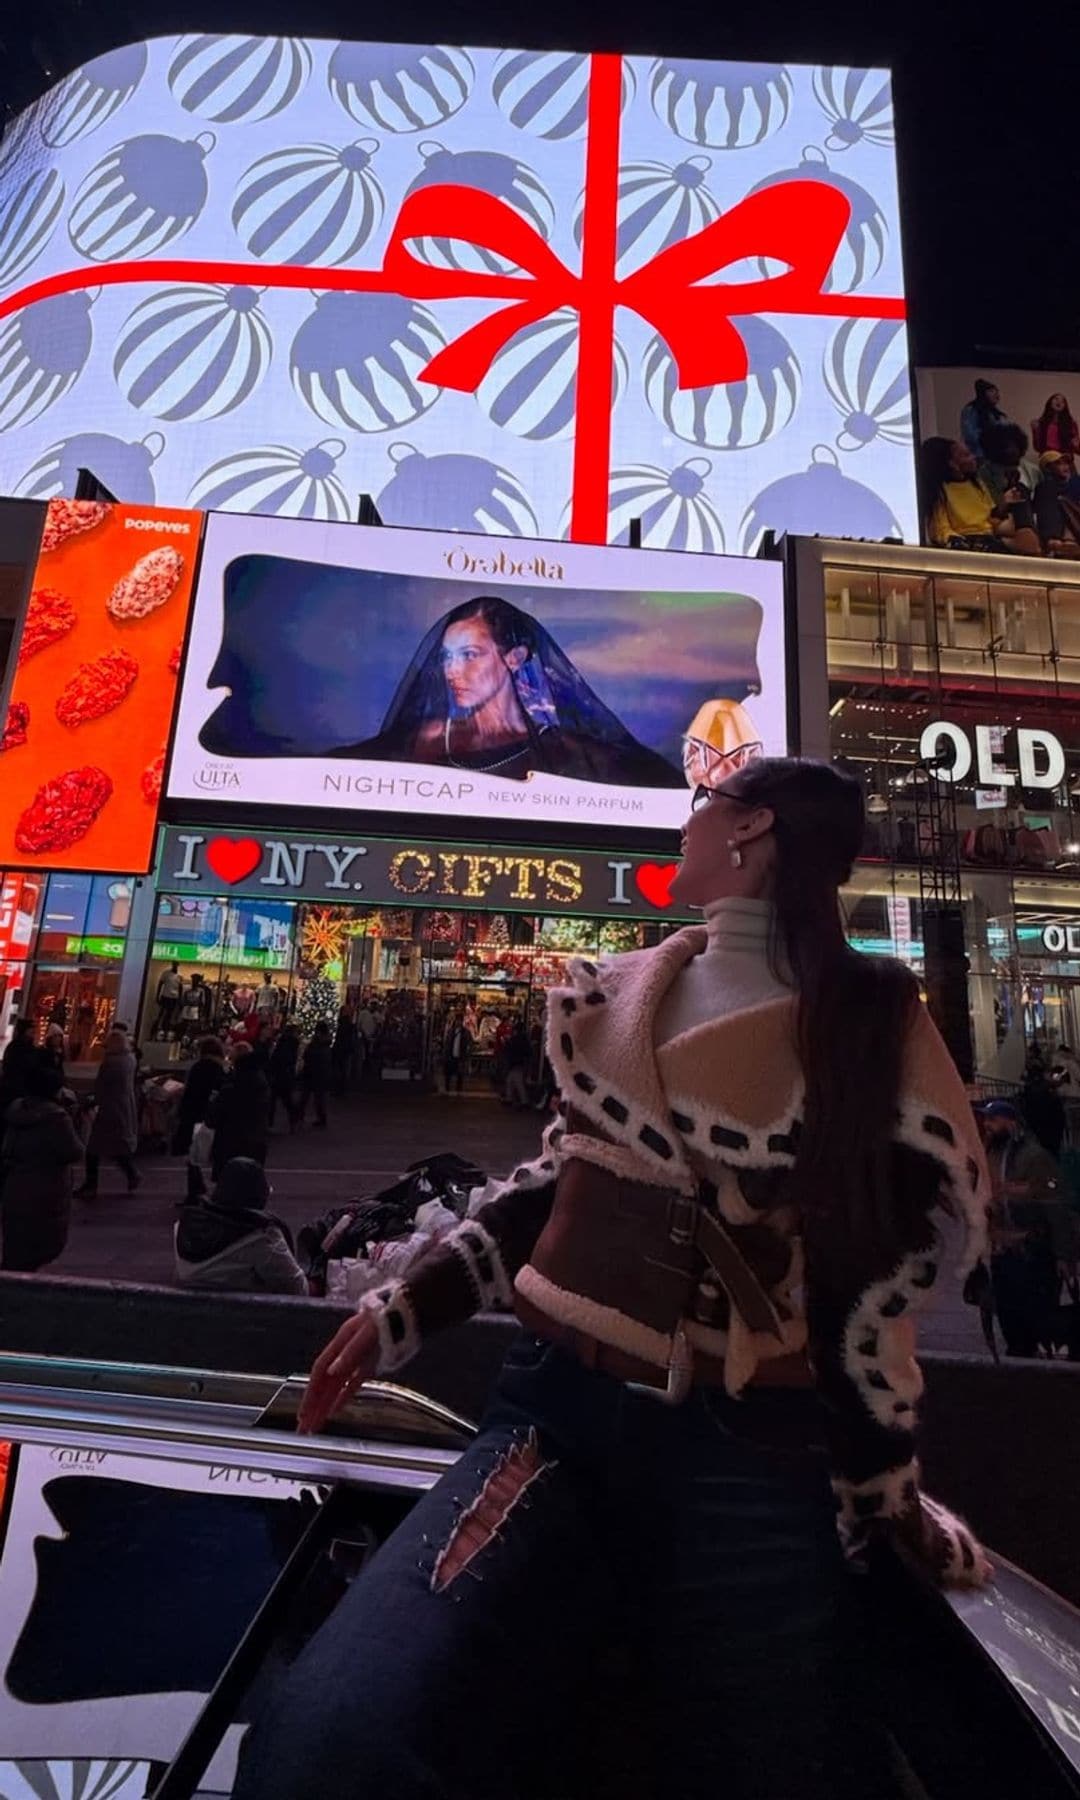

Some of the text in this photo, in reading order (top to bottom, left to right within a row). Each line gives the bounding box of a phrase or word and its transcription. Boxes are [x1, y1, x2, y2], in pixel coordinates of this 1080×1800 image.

[920, 721, 1065, 788] OLD
[200, 770, 240, 786] ULTA
[323, 774, 644, 811] NIGHTCAP NEW SKIN PARFUM
[387, 849, 583, 903] GIFTS
